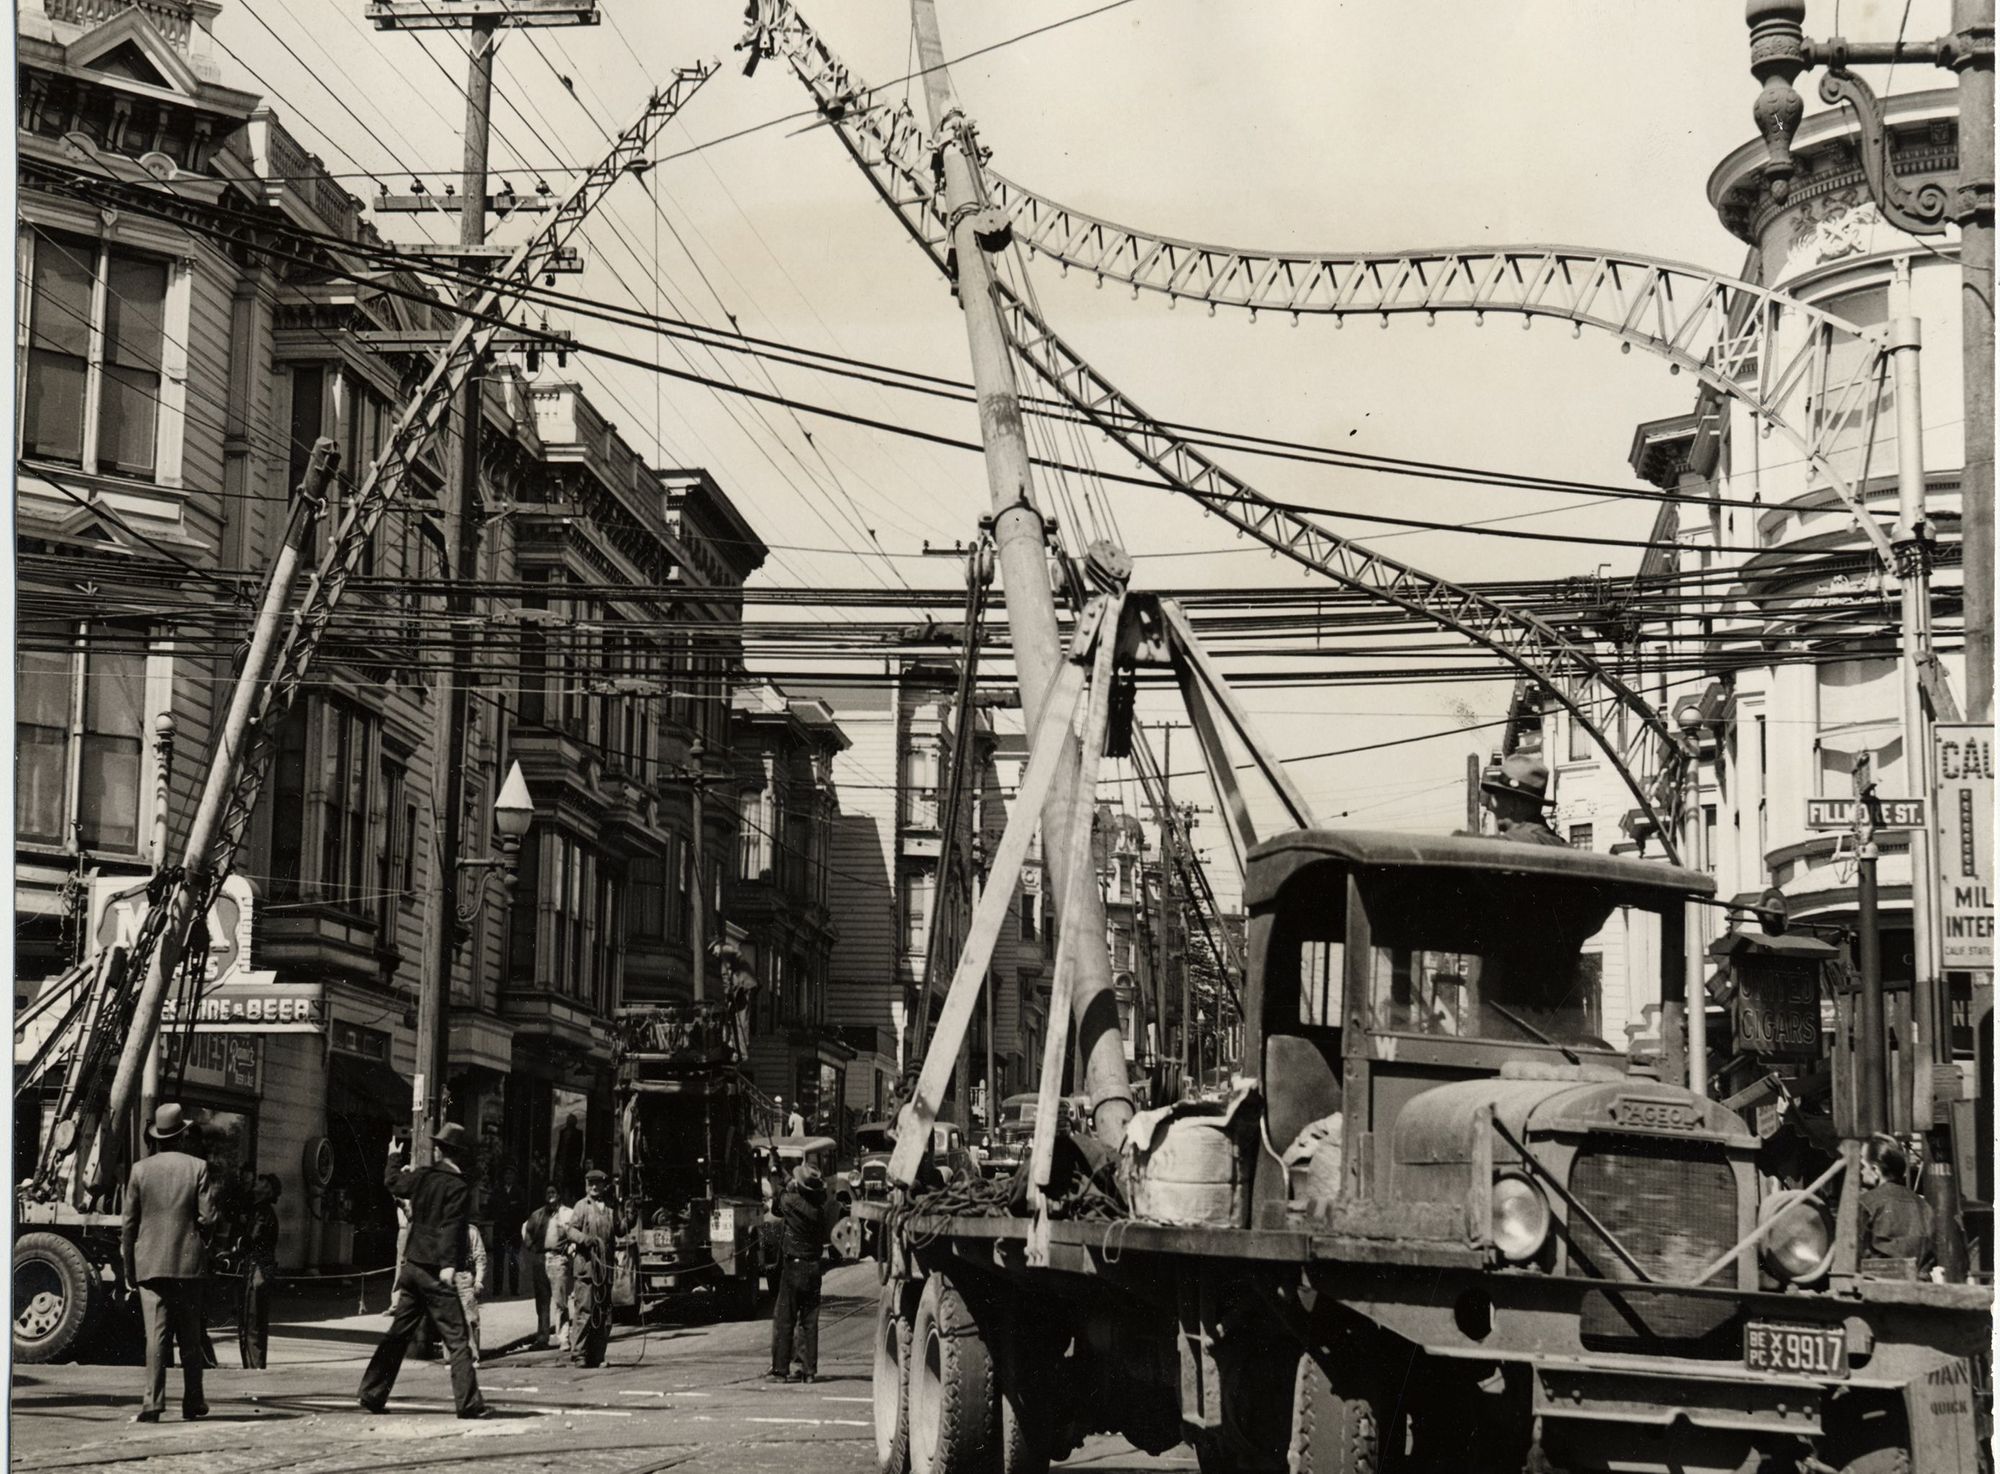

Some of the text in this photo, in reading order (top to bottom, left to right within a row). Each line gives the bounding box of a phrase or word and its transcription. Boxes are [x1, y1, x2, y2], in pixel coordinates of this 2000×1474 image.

[1895, 804, 1923, 824] ST.
[247, 999, 310, 1021] BEER
[1741, 1007, 1817, 1046] CIGARS
[1375, 1035, 1398, 1062] W
[1749, 1331, 1767, 1349] BE
[1786, 1333, 1842, 1372] 9917
[1749, 1349, 1767, 1366] PC
